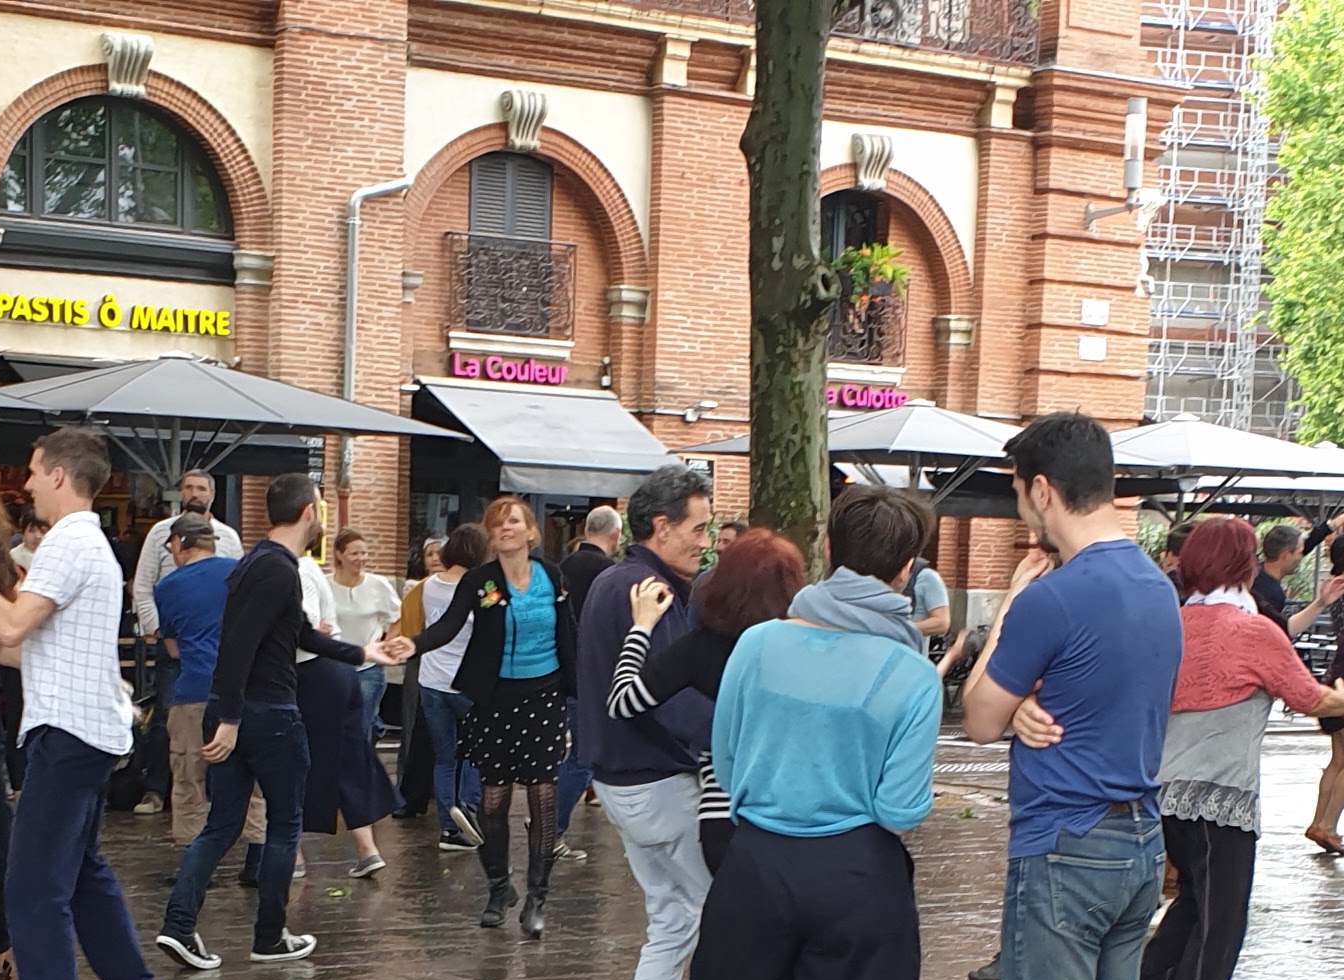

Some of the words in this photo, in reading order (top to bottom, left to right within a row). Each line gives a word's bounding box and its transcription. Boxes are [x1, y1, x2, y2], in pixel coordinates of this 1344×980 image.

[99, 293, 123, 328] Ô
[131, 304, 231, 336] MAITRE
[451, 351, 480, 377] La
[484, 355, 569, 385] Couleur
